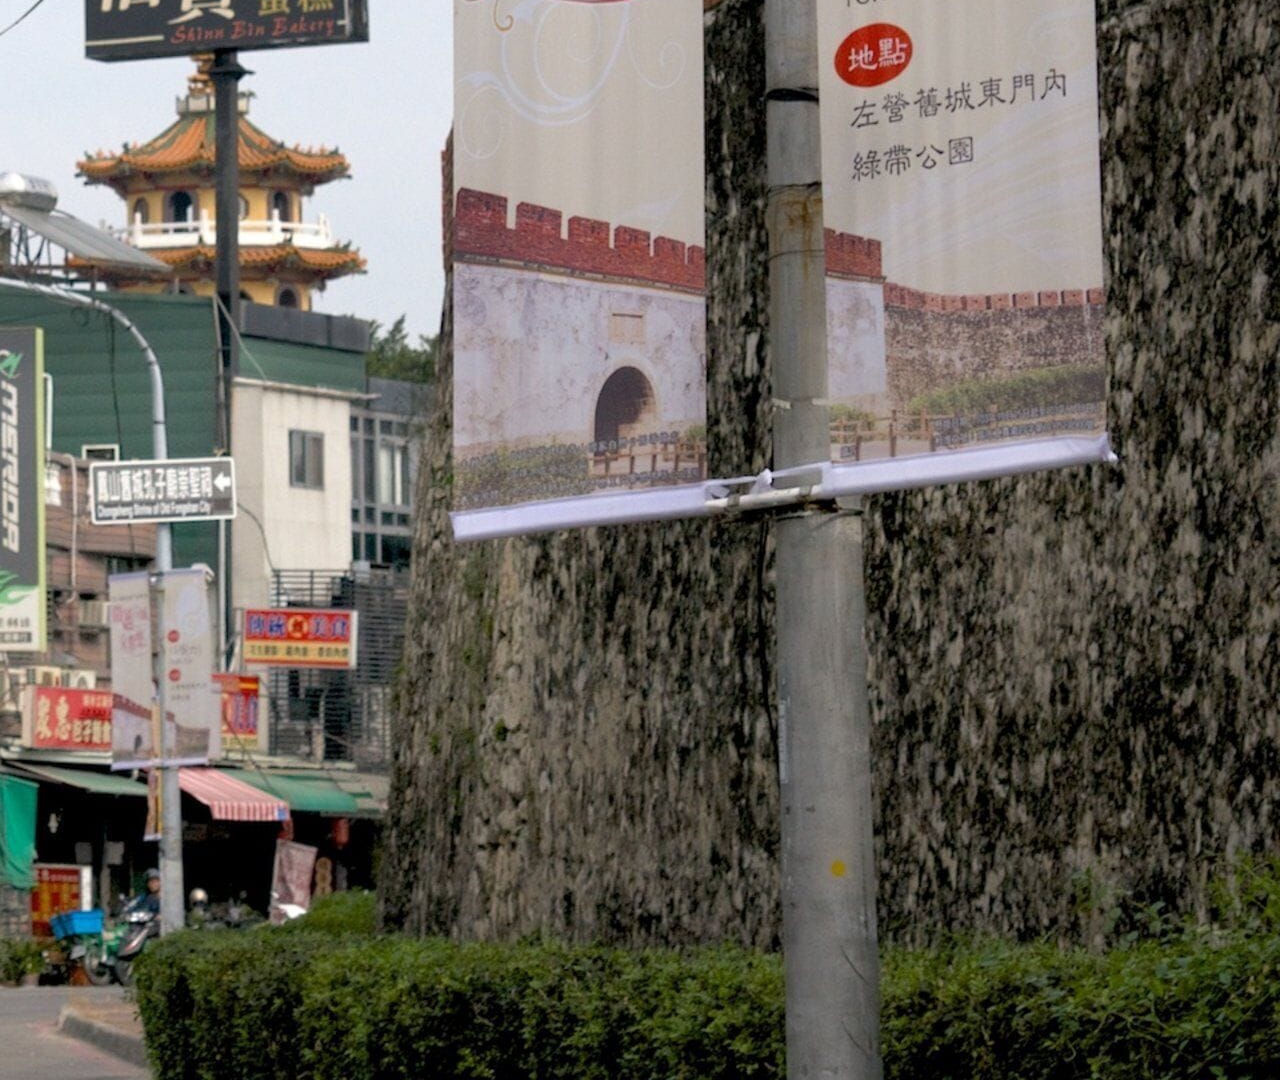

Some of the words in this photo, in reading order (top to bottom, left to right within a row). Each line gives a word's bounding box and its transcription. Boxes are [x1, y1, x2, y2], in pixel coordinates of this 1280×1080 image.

[170, 22, 224, 44] Shinn
[230, 19, 265, 39] Bin
[272, 15, 334, 37] Bakery
[848, 38, 907, 73] 地點
[851, 69, 1067, 129] 左營舊城東門內
[852, 136, 974, 183] 綠帶公園
[1, 380, 19, 555] MERIDA
